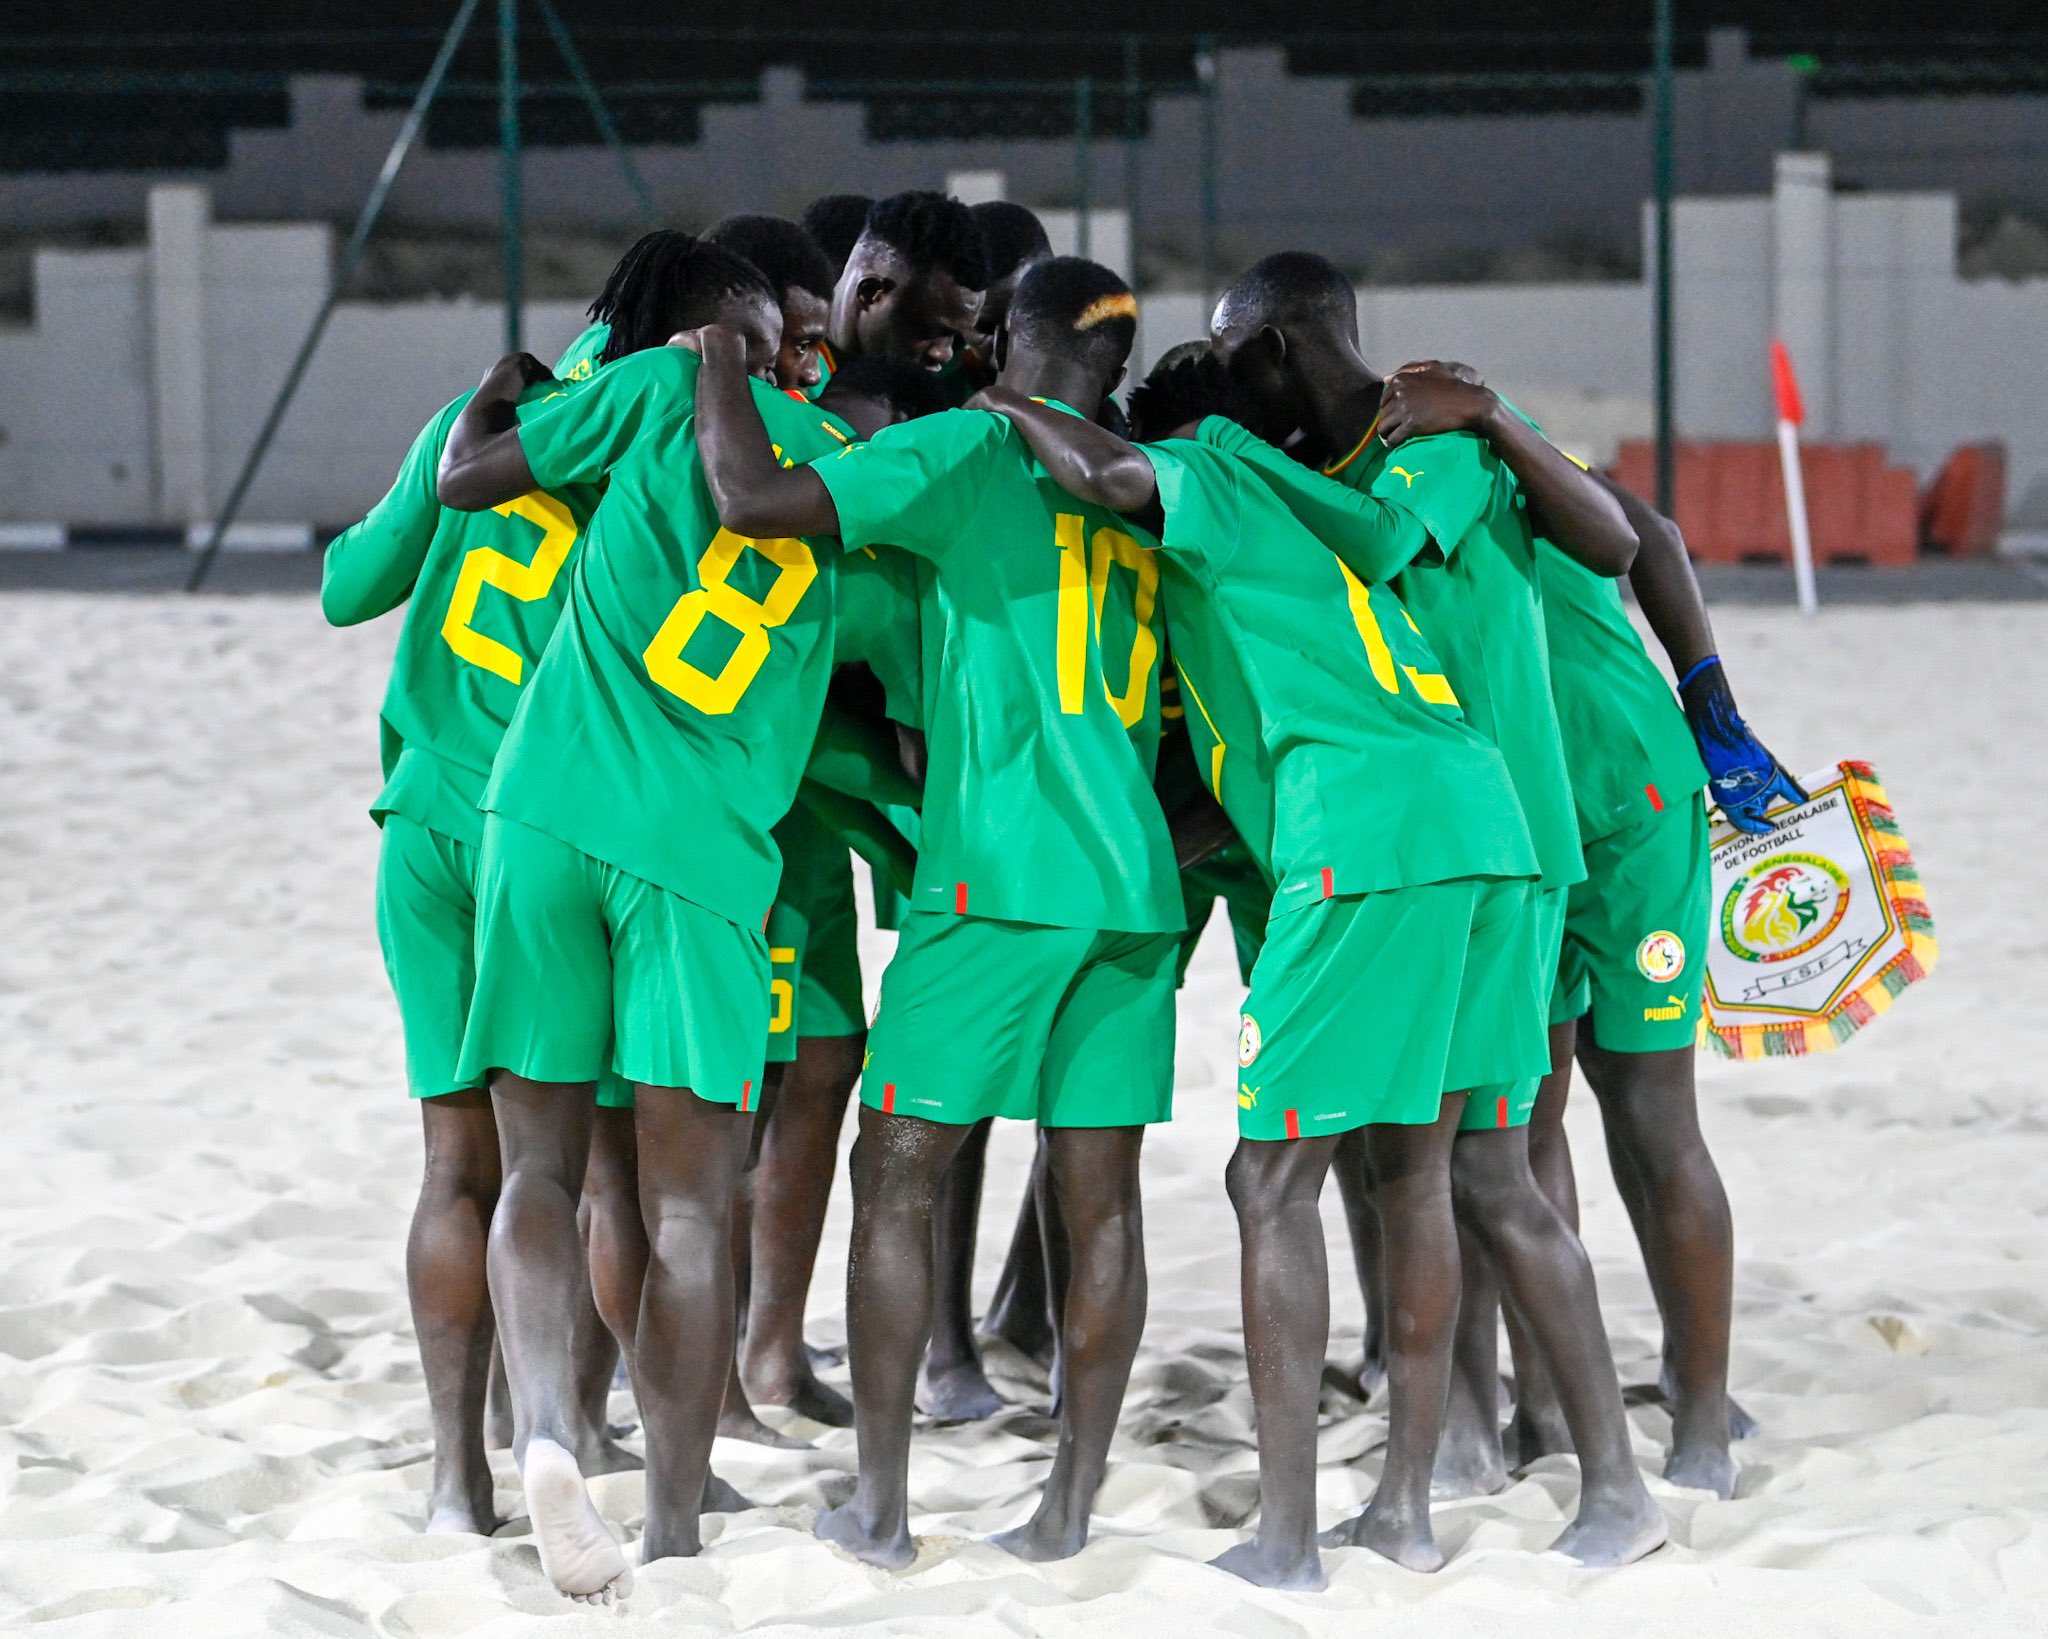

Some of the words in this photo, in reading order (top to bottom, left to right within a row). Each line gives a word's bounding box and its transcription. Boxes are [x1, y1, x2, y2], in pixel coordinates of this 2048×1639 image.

[441, 490, 578, 686] 2
[642, 525, 819, 716] 8
[1055, 512, 1159, 730] 10
[1724, 856, 1741, 871] DE
[1742, 828, 1805, 861] FOOTBALL
